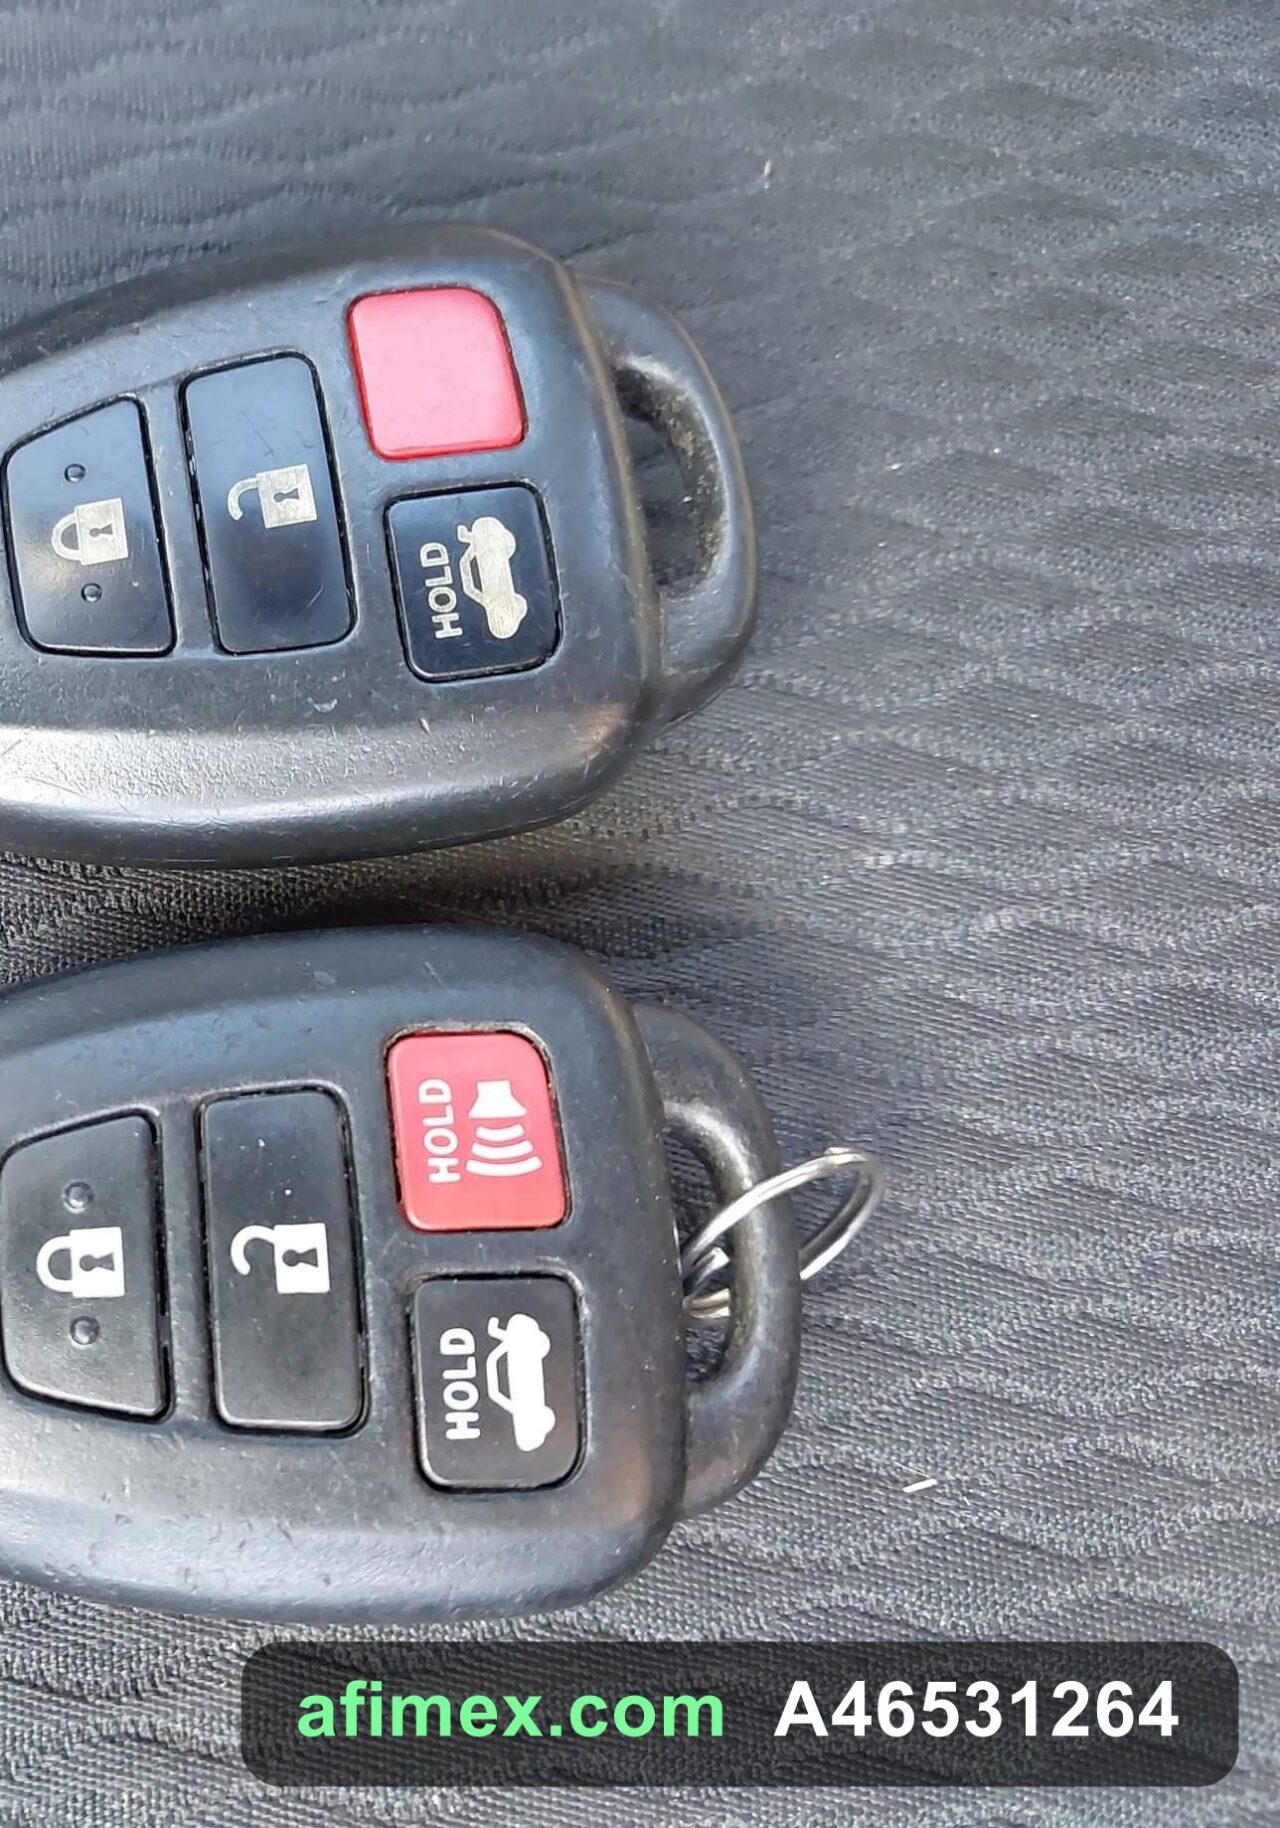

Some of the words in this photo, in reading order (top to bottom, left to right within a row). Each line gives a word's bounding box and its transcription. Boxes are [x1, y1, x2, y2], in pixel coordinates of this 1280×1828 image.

[420, 542, 463, 639] HOLD
[418, 1078, 461, 1183] HOLD
[439, 1327, 481, 1440] HOLD
